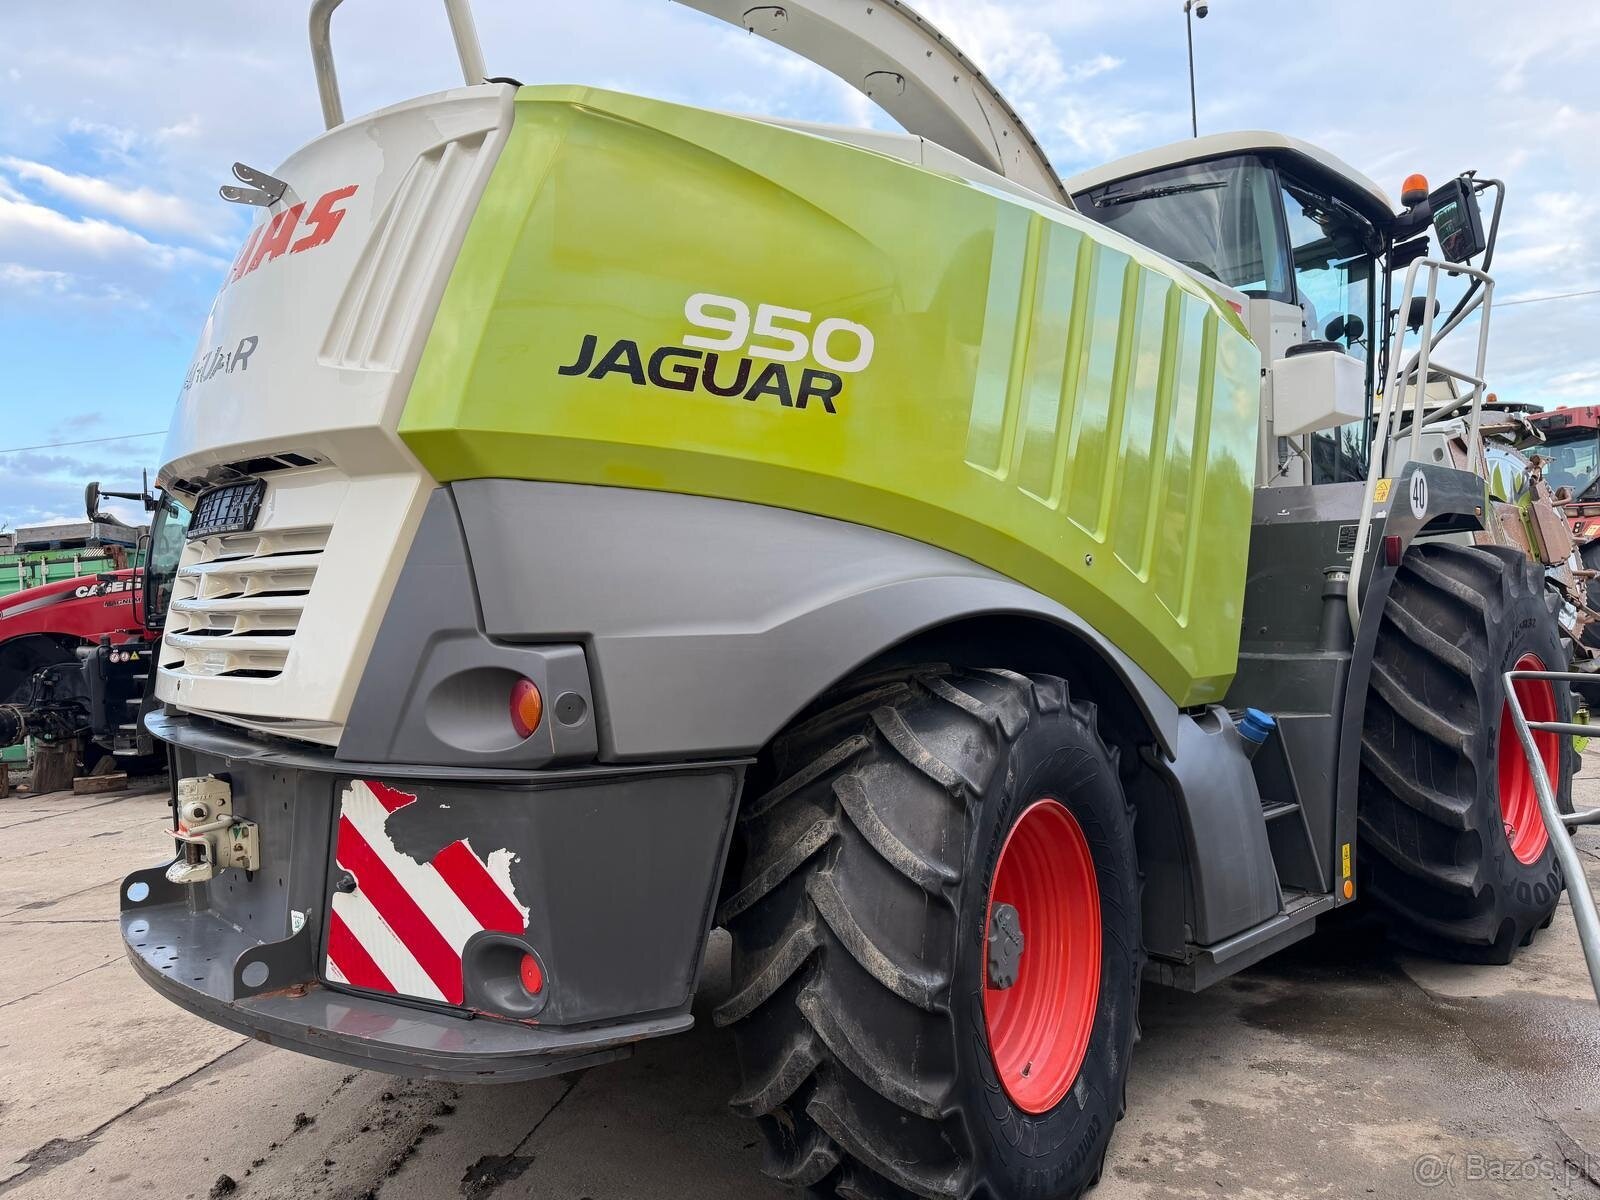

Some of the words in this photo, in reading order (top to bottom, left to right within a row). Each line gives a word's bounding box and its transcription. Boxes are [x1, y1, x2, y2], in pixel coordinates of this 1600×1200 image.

[682, 292, 875, 373] 950
[557, 334, 843, 414] JAGUAR
[1412, 477, 1424, 510] 40
